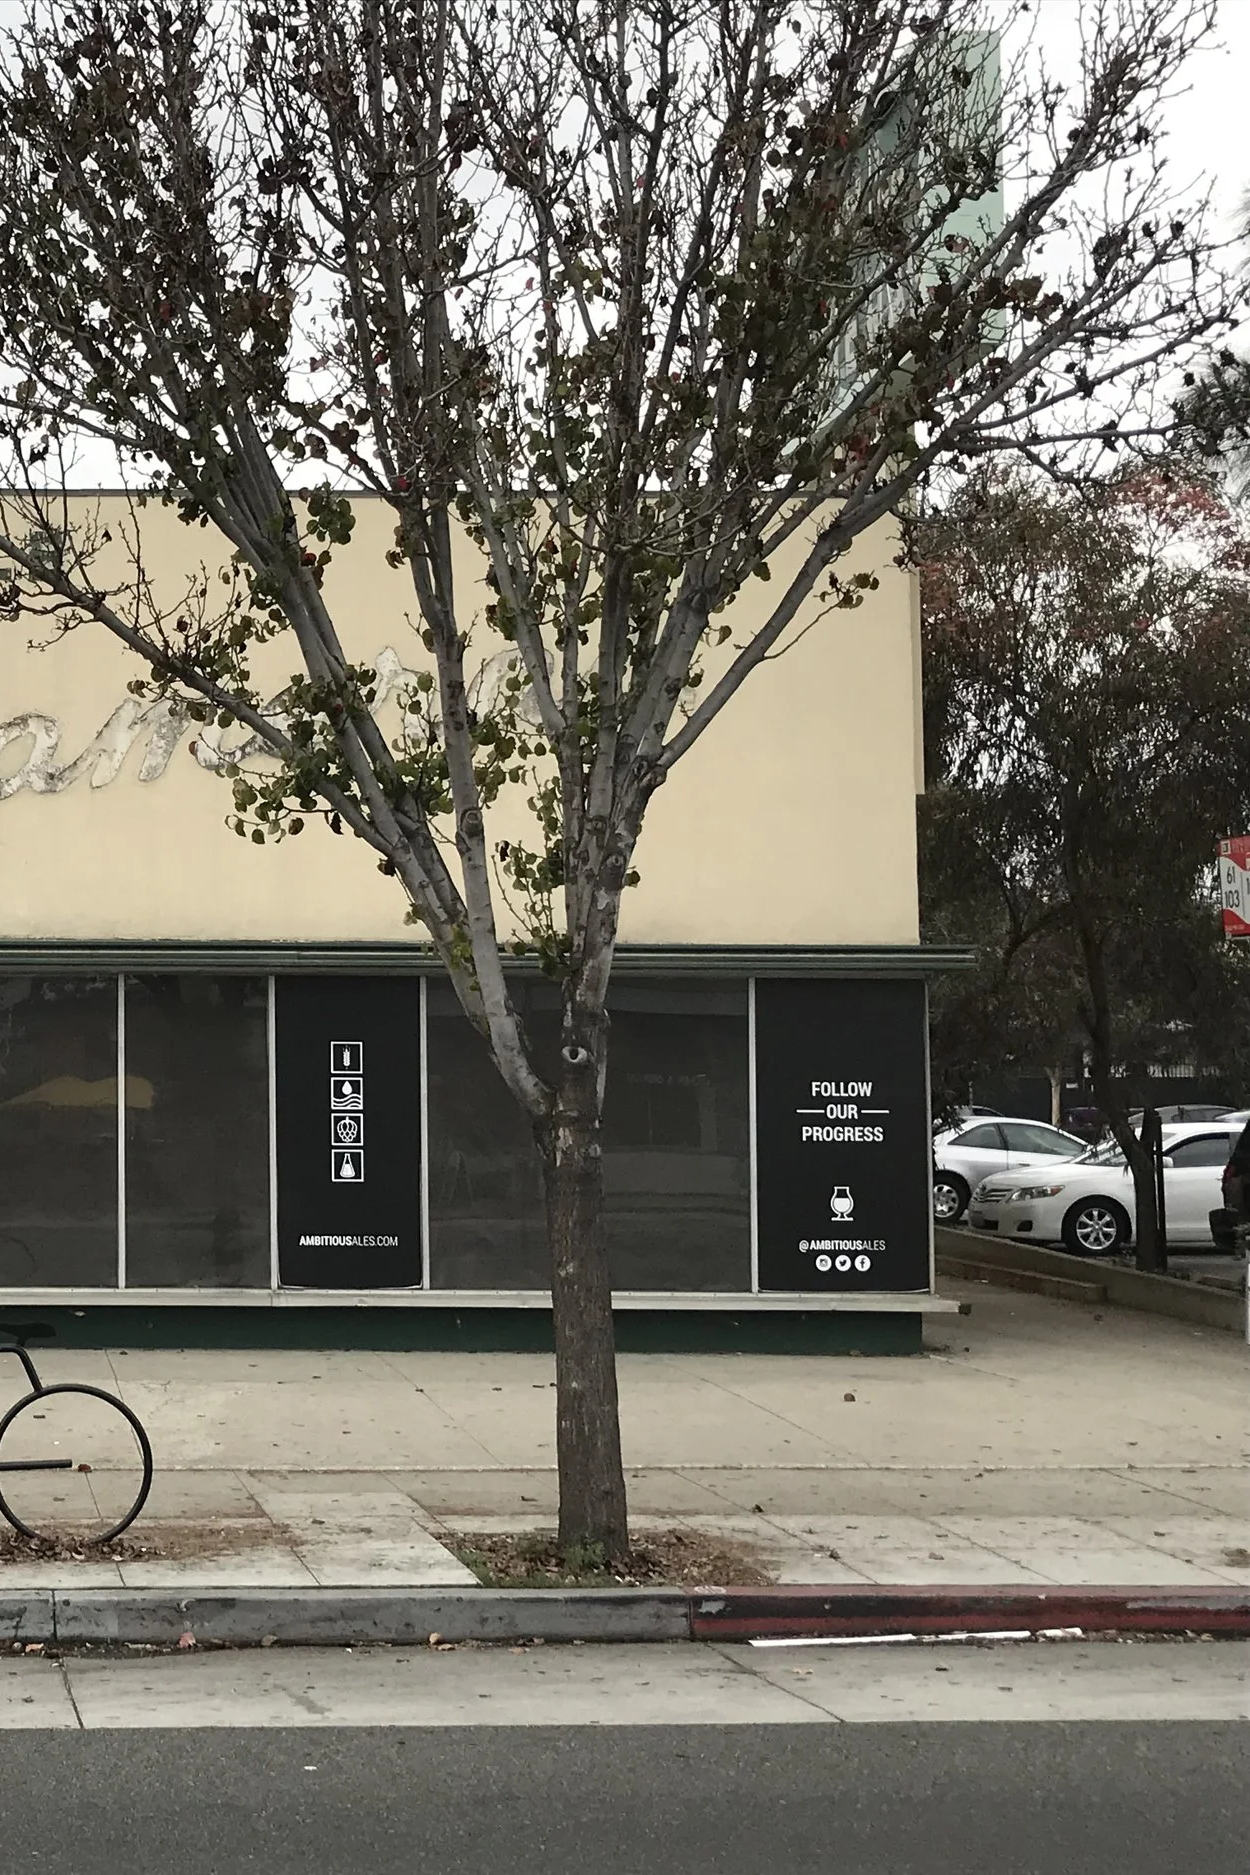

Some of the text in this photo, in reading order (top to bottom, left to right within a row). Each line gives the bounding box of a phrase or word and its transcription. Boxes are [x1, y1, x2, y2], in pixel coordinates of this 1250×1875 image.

[1224, 889, 1240, 909] 103
[811, 1081, 873, 1097] FOLLOW
[826, 1103, 859, 1120] OUR
[802, 1126, 884, 1142] PROGRESS
[298, 1235, 399, 1247] AMBITIOUSALES.COM
[798, 1239, 886, 1253] @AMBITIOUSALES
